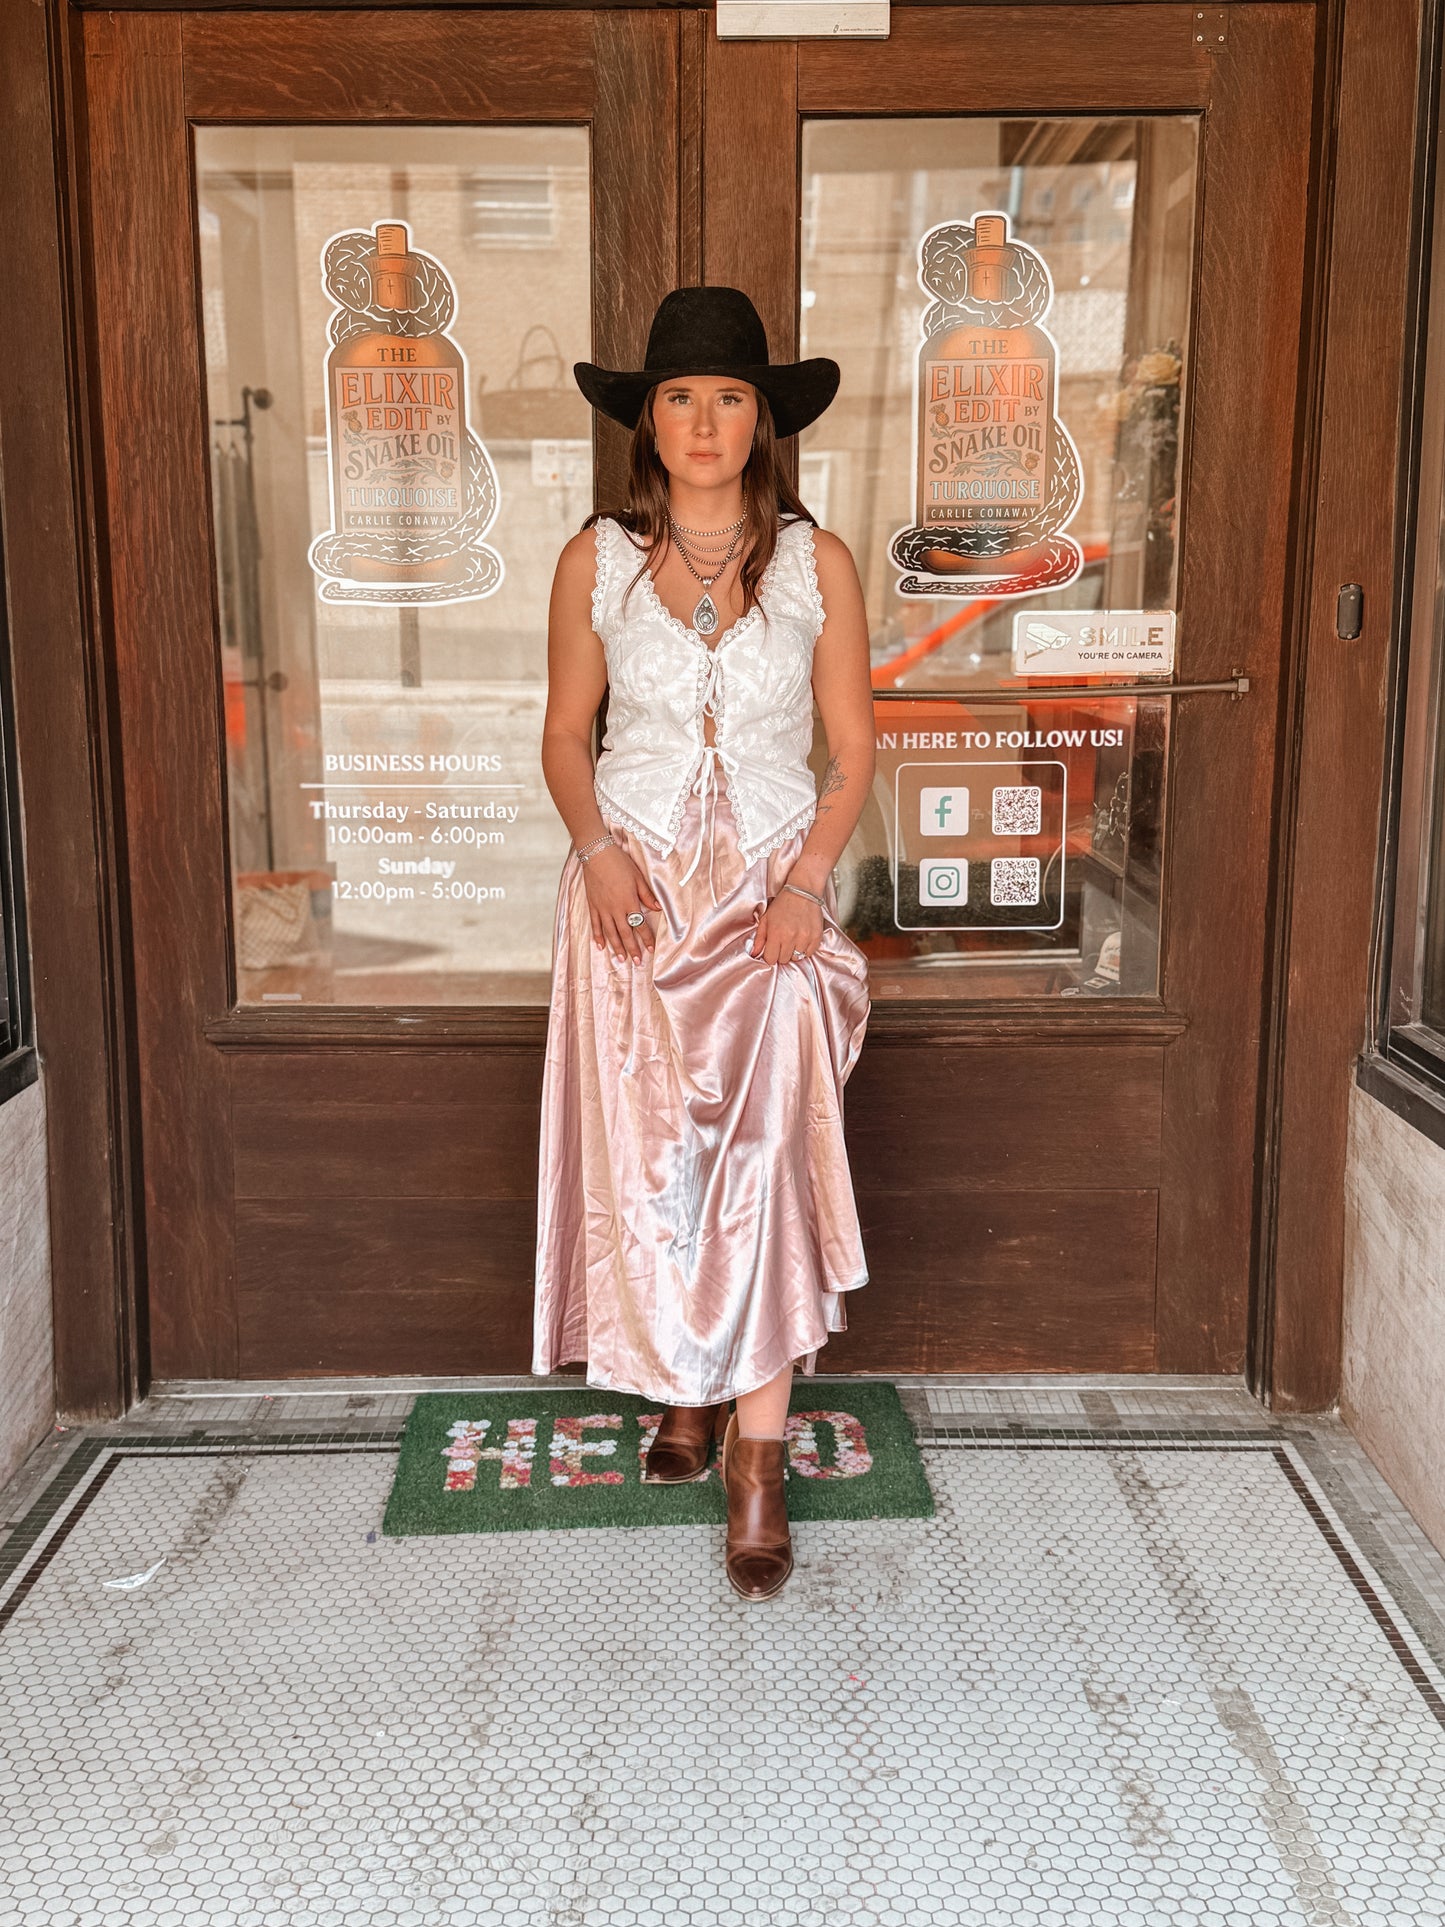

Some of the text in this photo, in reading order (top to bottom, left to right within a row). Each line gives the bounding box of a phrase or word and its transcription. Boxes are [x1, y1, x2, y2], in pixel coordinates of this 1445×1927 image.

[377, 347, 417, 362] THE
[969, 339, 1009, 355] THE
[341, 372, 455, 410] ELIXIR
[930, 364, 1044, 402] ELIXIR
[366, 407, 452, 431] EDIT BY
[954, 399, 1040, 423] EDIT BY
[344, 433, 458, 481] SNAKE OIL
[928, 424, 1043, 474] SNAKE OIL
[346, 486, 457, 508] TURQUOISE
[930, 479, 1040, 500] TURQUOISE
[350, 515, 455, 526] CARLIE CONAWAY
[931, 507, 1036, 519] CARLIE CONAWAY
[1078, 626, 1164, 647] SMILE
[1078, 652, 1163, 660] YOU'RE ON CAMERA
[902, 732, 958, 750] HERE
[961, 731, 991, 749] TO
[995, 730, 1087, 748] FOLLOW
[1090, 729, 1123, 747] US!
[325, 754, 503, 772] BUSINESS HOURS
[309, 801, 409, 823] Thursday
[425, 801, 519, 823] Saturday
[328, 826, 413, 844] 10:00am
[431, 826, 505, 849] 6:00pm
[378, 857, 456, 878] Sunday
[331, 881, 415, 905] 12:00pm
[431, 881, 506, 905] 5:00pm
[441, 1410, 874, 1491] HEO
